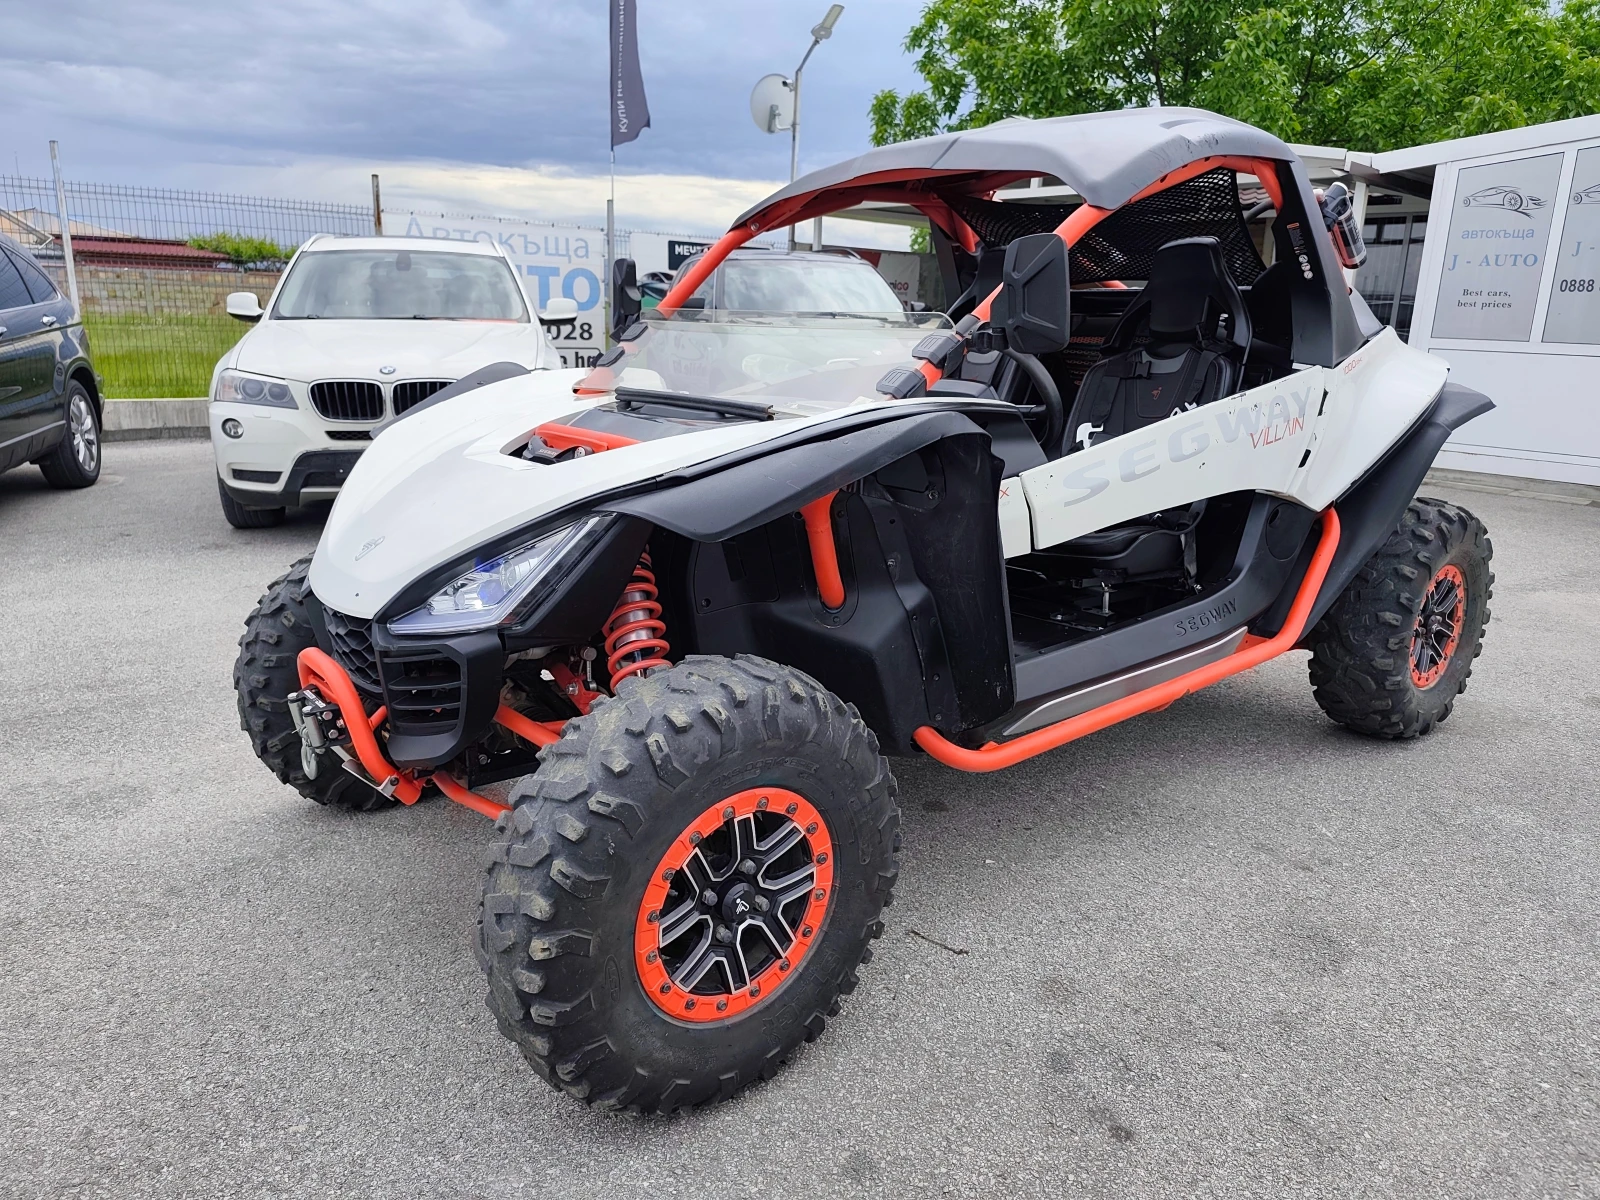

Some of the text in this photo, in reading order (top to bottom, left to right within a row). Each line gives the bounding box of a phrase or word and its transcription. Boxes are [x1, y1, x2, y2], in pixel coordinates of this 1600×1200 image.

[616, 100, 629, 133] Купи
[1461, 228, 1535, 241] автокъща
[1448, 254, 1459, 271] J
[1478, 253, 1538, 267] AUTO
[1462, 288, 1511, 298] Best cars,
[1559, 278, 1595, 293] 0888
[1457, 299, 1512, 310] best prices
[1249, 414, 1305, 450] VILLAIN
[1063, 386, 1311, 508] SEGWAY
[1173, 597, 1237, 638] SEGWAY
